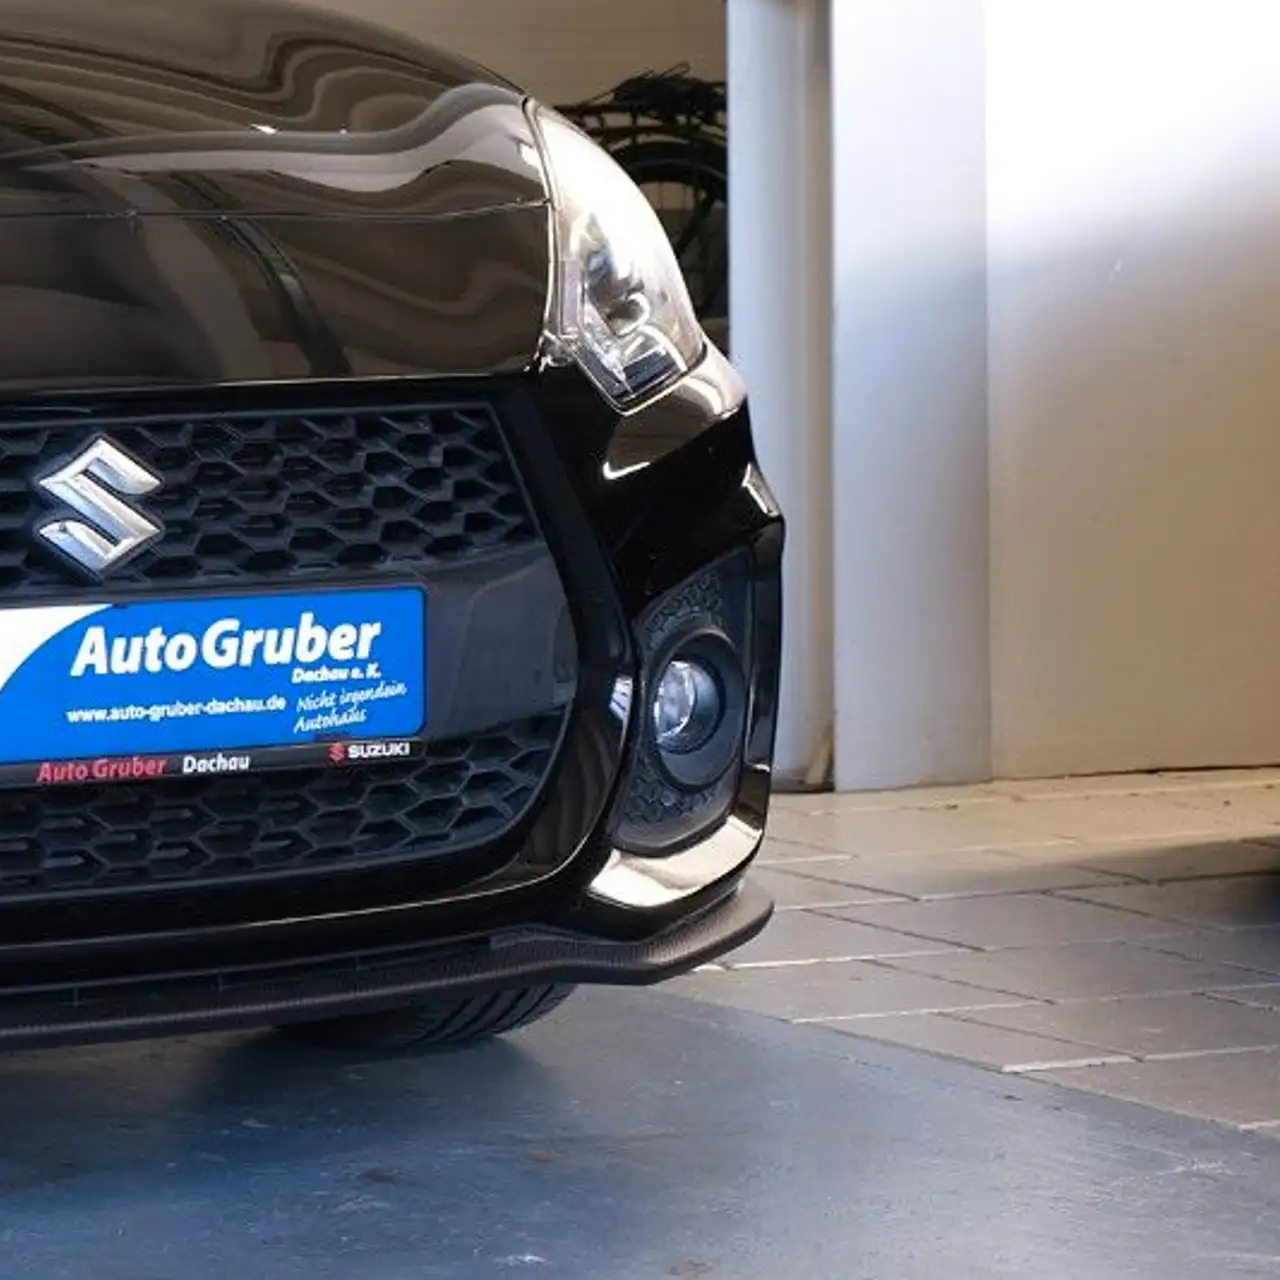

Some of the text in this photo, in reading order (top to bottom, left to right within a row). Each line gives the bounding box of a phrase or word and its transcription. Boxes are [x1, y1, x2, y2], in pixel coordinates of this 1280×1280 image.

[291, 666, 349, 684] Dachau
[296, 680, 408, 713] Nicht irgendein
[67, 695, 287, 723] www.auto-gruber-dachau.de
[293, 707, 367, 734] Autohaus
[347, 741, 410, 759] SUZUKI
[92, 756, 167, 780] Gruber
[182, 751, 250, 775] Dachau
